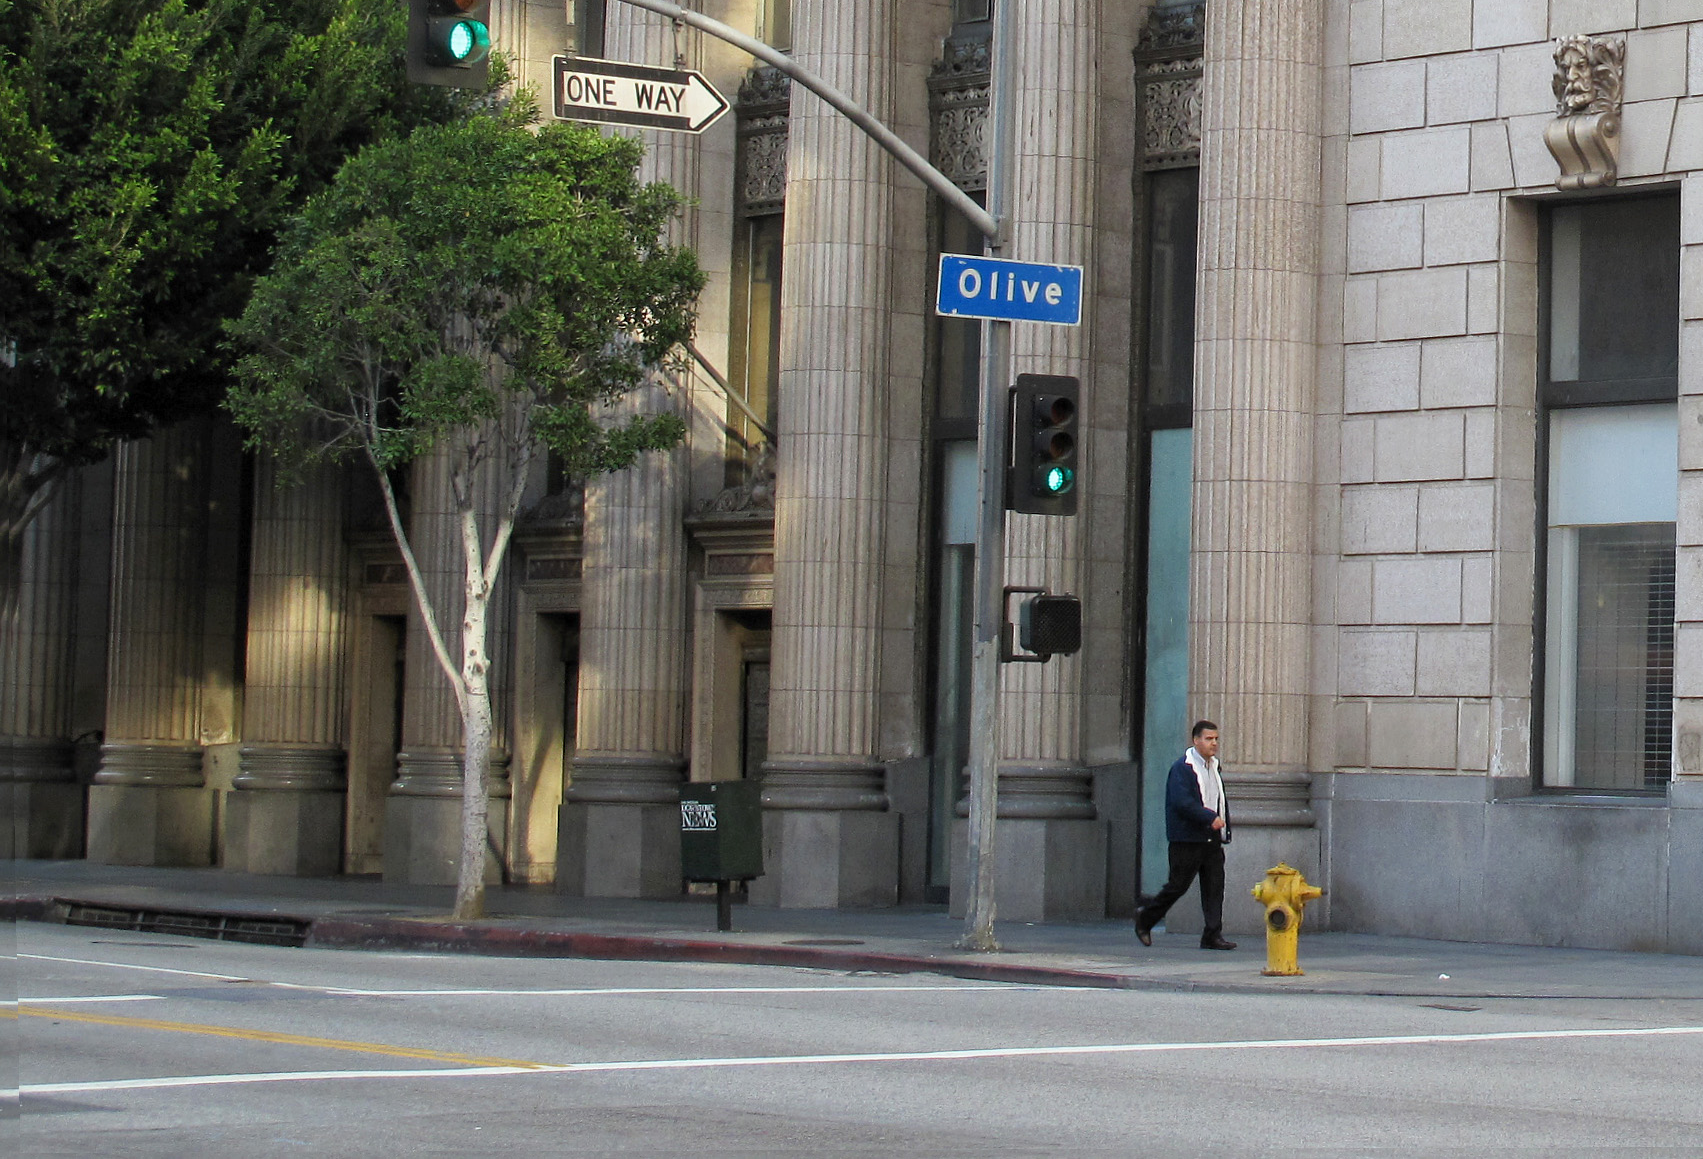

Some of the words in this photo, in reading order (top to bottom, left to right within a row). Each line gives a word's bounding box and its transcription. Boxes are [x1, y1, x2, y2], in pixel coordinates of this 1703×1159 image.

[567, 75, 617, 106] ONE
[635, 83, 686, 113] WAY
[959, 268, 1062, 305] Olive
[682, 810, 717, 828] NEWS
